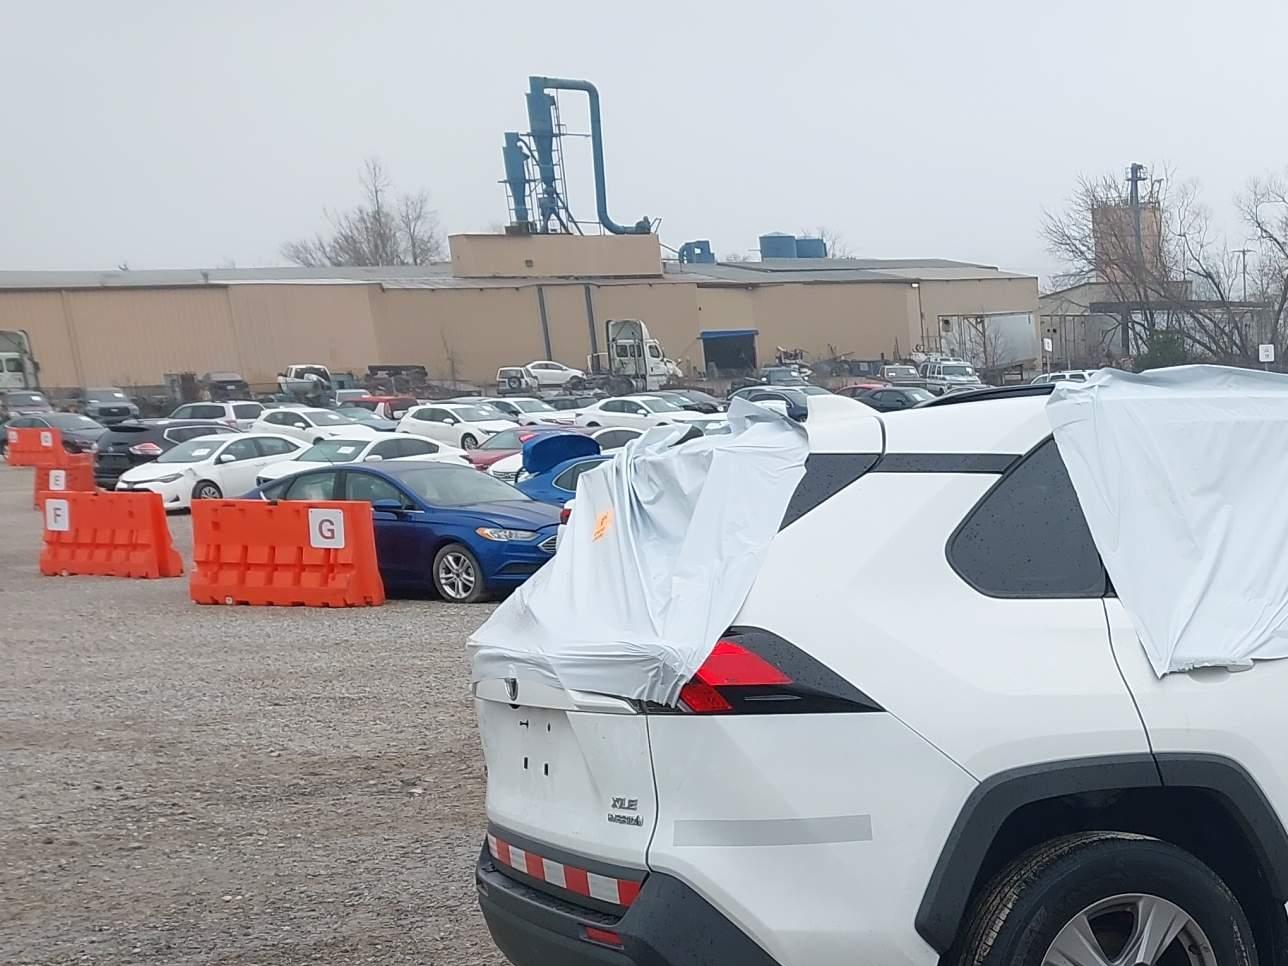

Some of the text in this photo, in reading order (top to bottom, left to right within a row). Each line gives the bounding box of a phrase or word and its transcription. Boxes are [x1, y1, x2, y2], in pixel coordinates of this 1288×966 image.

[53, 507, 62, 524] F
[318, 519, 336, 540] G
[611, 797, 638, 811] XLE
